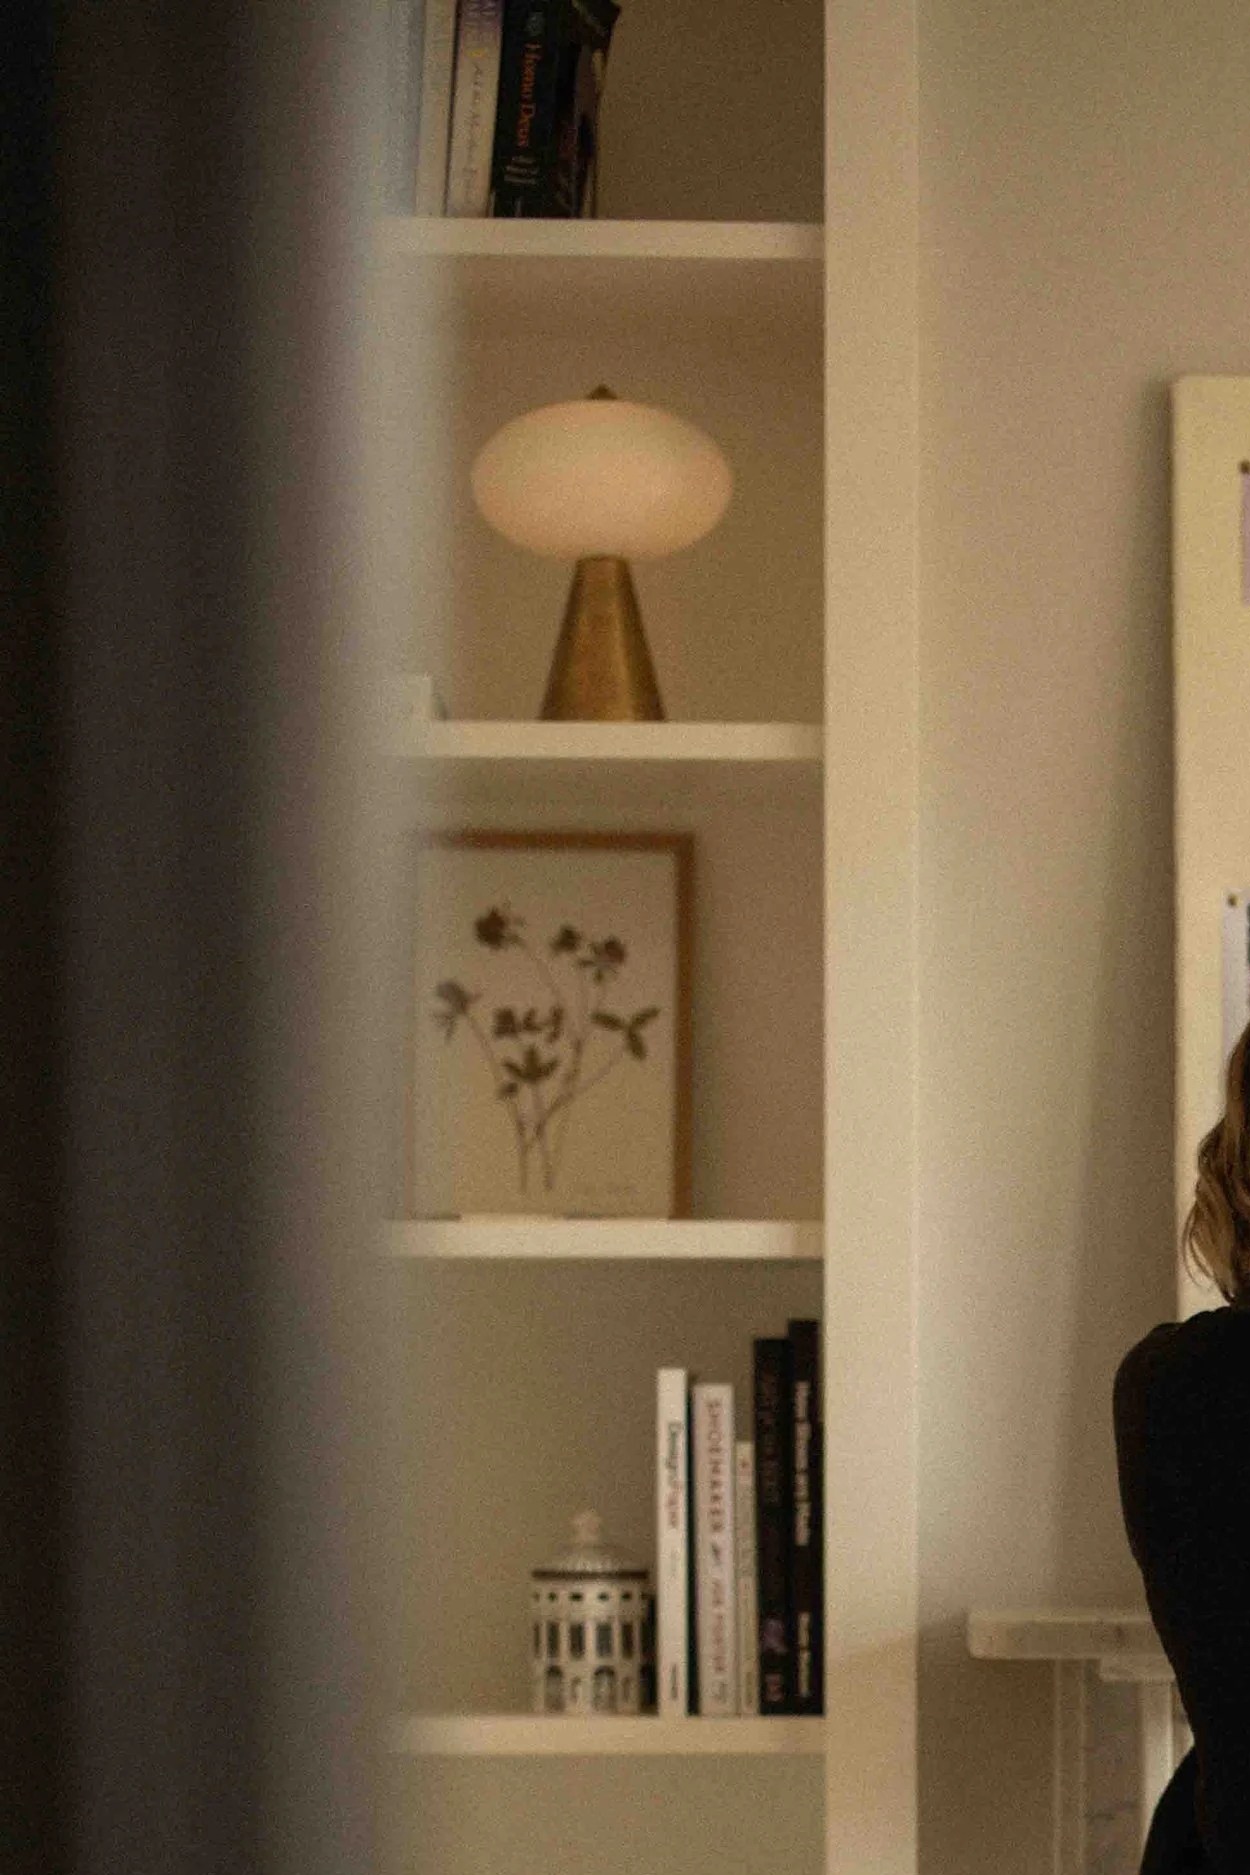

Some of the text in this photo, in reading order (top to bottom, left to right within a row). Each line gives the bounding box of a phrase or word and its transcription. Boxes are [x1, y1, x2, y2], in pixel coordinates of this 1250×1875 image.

[520, 42, 542, 99] Homo
[516, 103, 537, 147] Deus
[706, 1399, 725, 1533] SHOEMAKER
